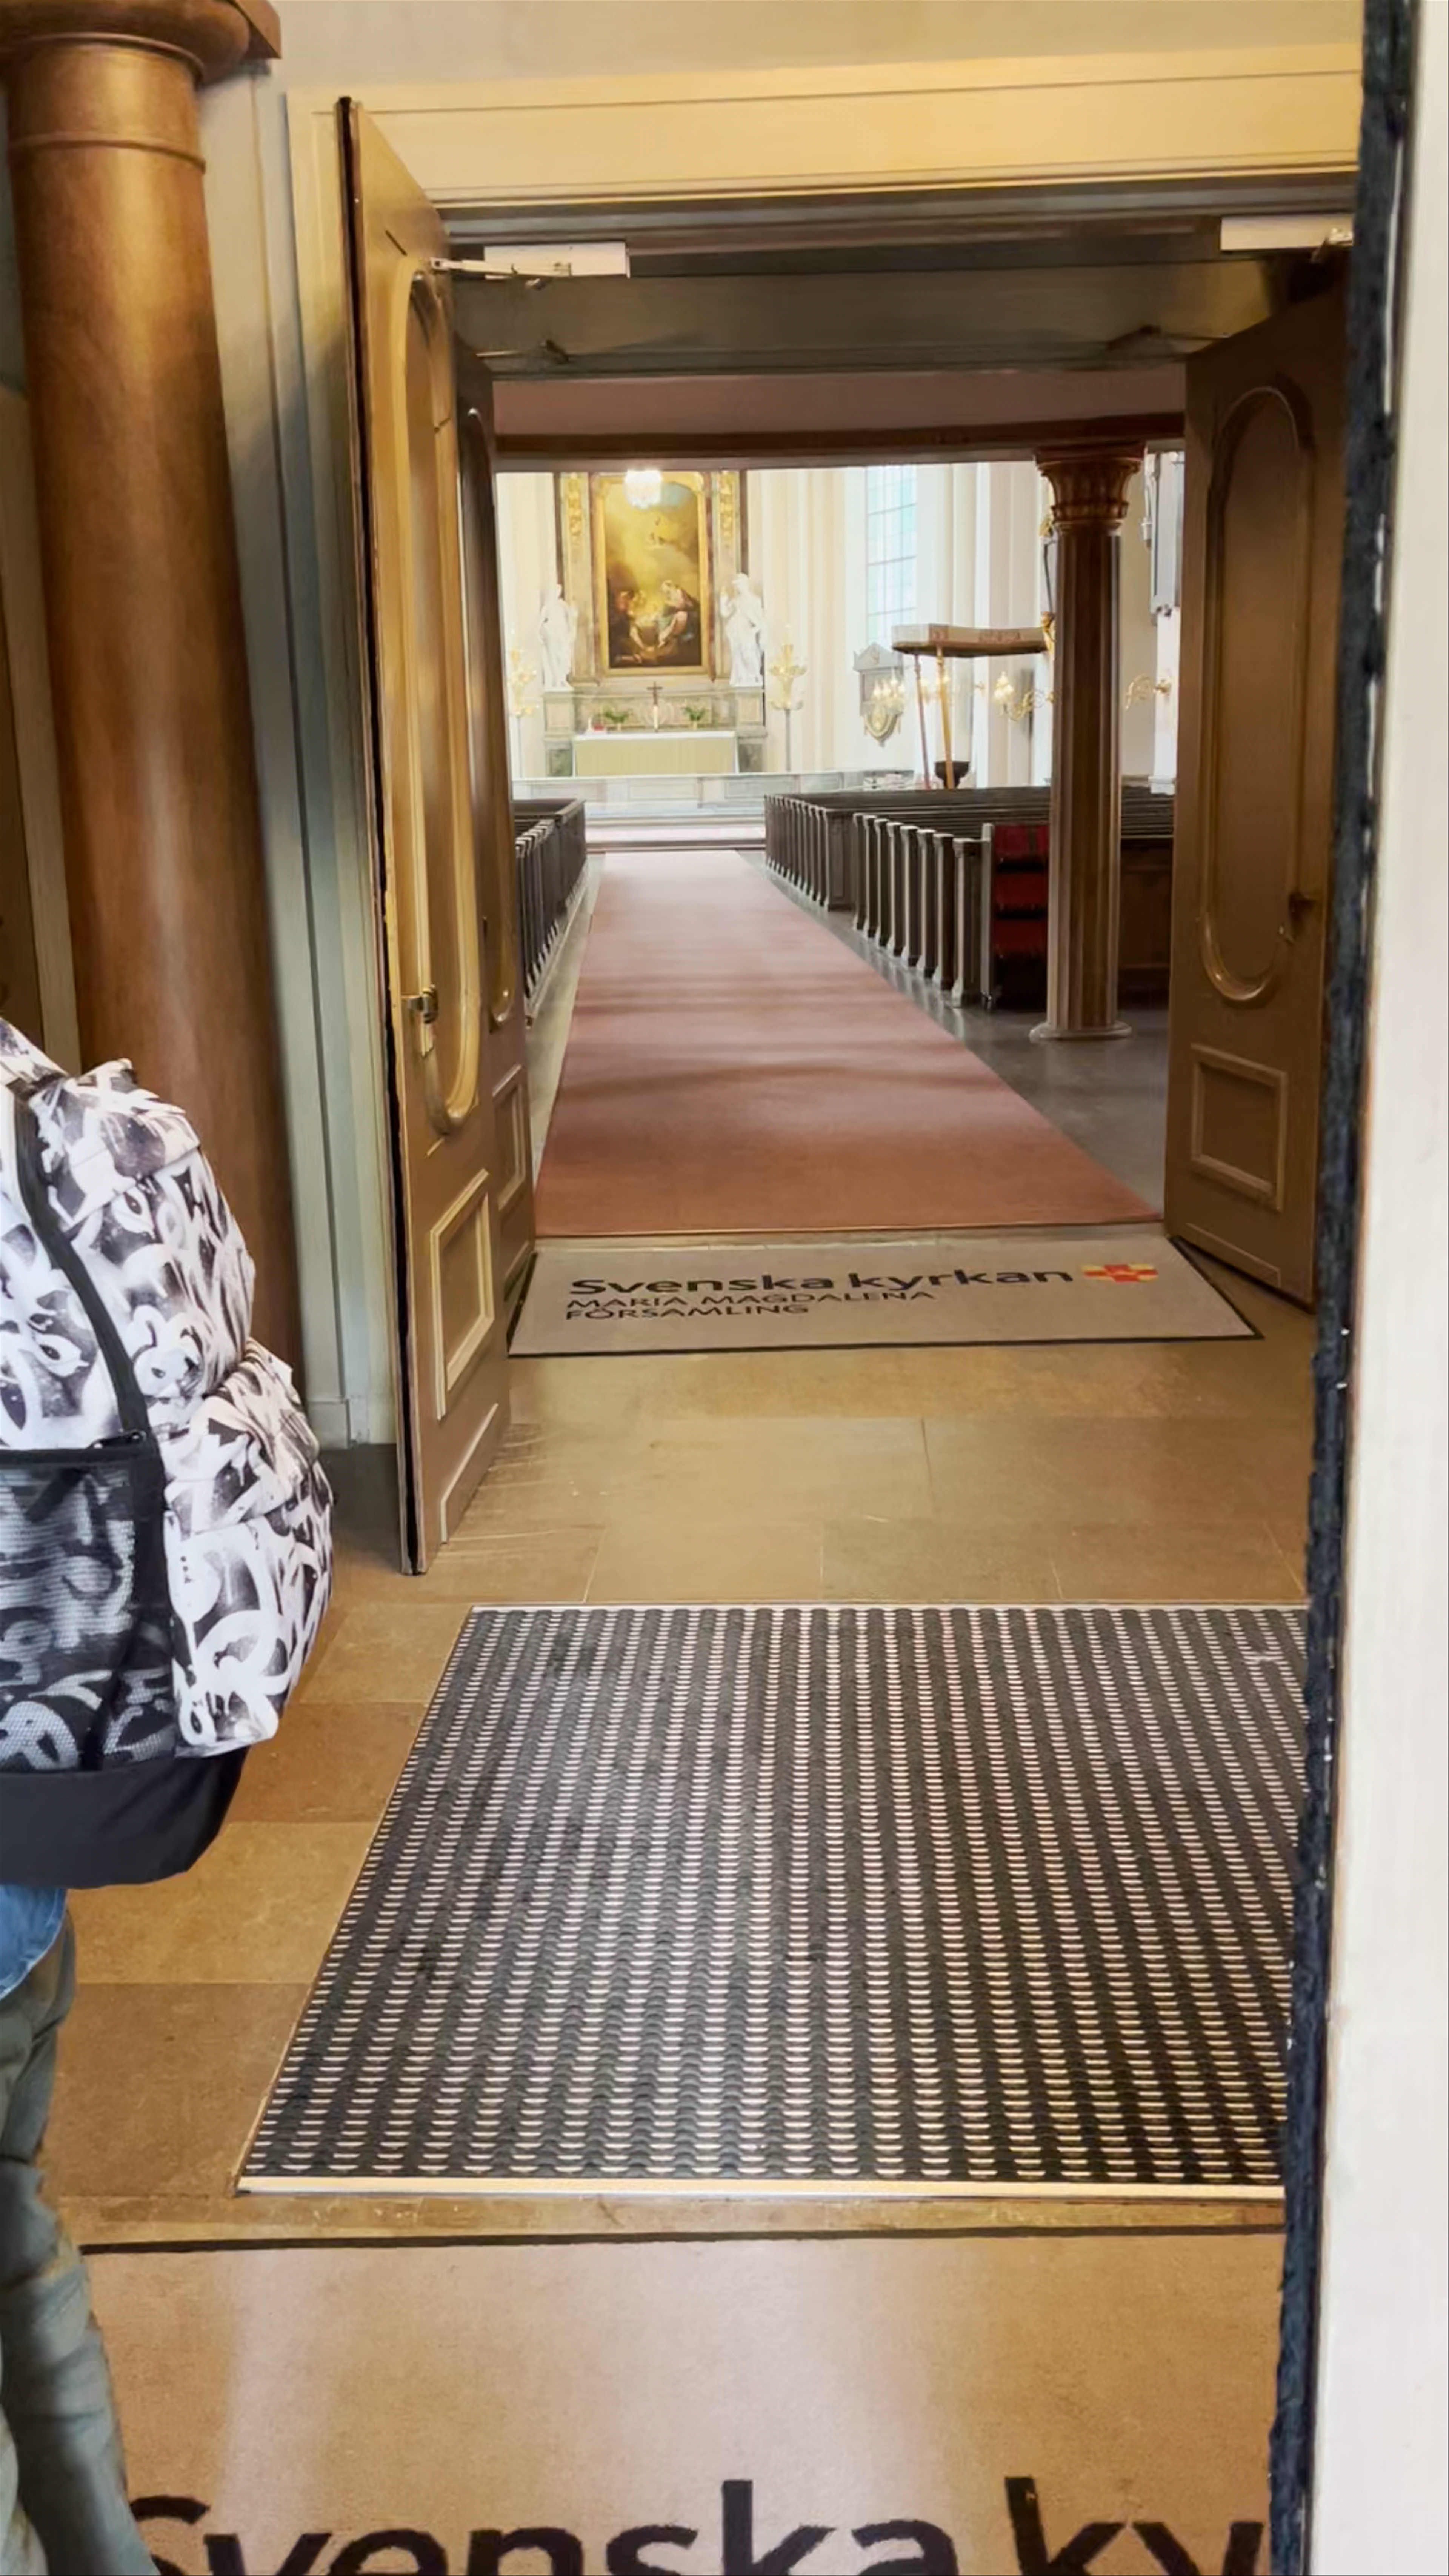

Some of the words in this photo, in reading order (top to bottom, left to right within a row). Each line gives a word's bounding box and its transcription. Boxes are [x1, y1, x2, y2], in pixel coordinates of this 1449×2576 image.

[570, 1275, 834, 1294] Svenska
[848, 1270, 1073, 1290] kyrkan
[567, 1296, 688, 1308] MARIA
[701, 1292, 935, 1304] MAGDALENA
[566, 1306, 808, 1320] FÖRSAMLING
